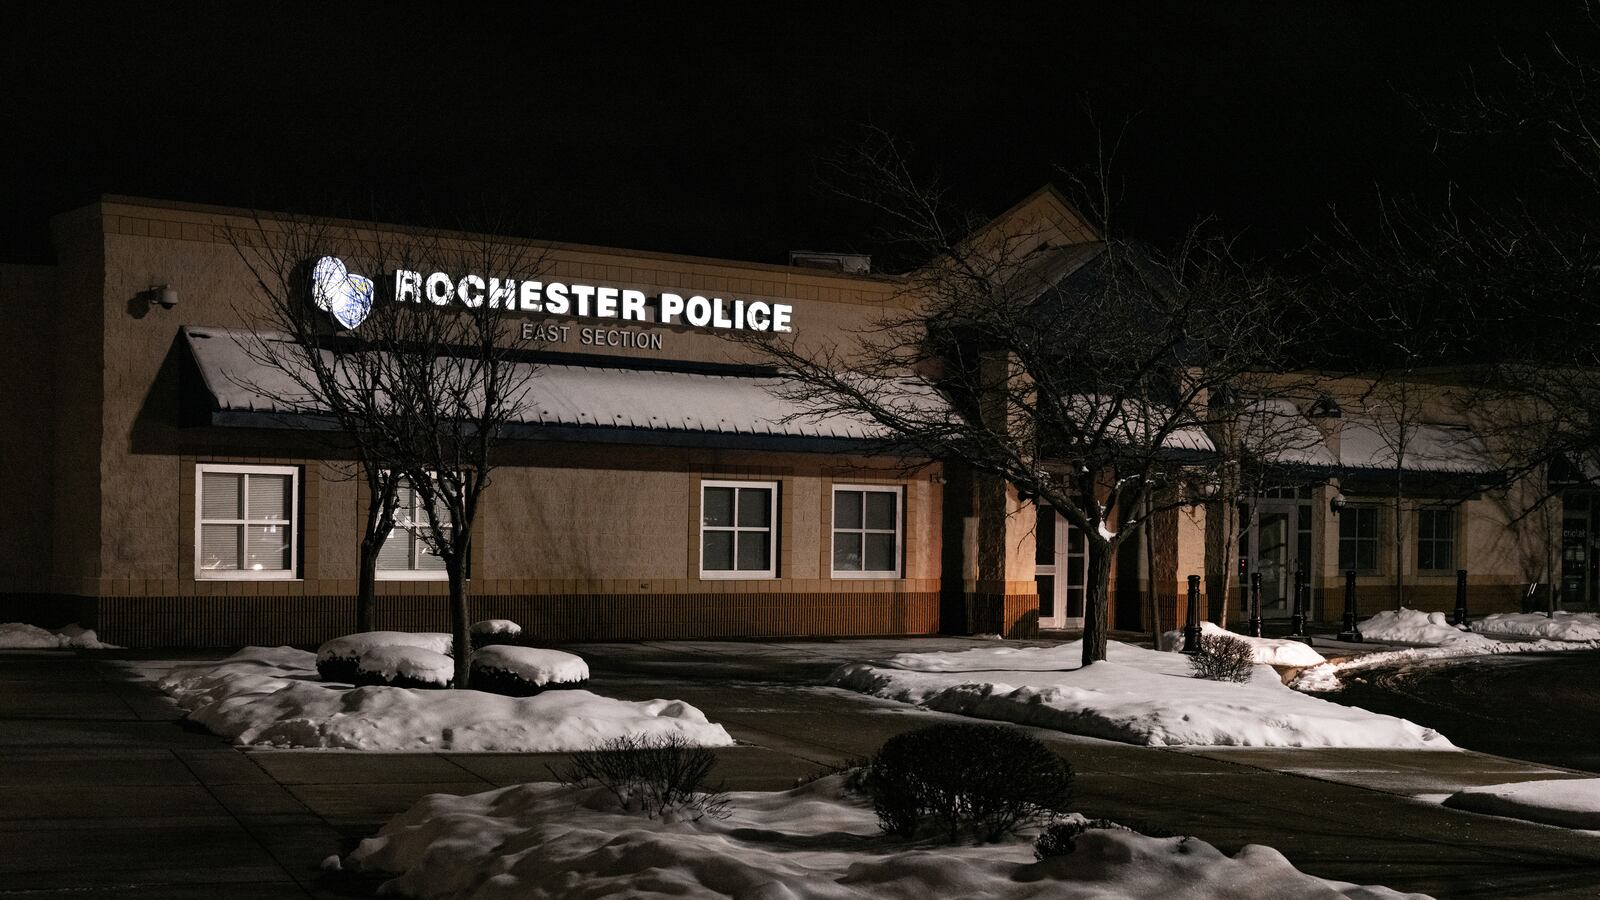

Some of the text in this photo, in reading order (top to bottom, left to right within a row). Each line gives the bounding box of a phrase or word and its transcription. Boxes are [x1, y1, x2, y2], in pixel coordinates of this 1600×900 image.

[395, 269, 793, 333] ROCHESTER POLICE
[522, 323, 664, 350] EAST SECTION
